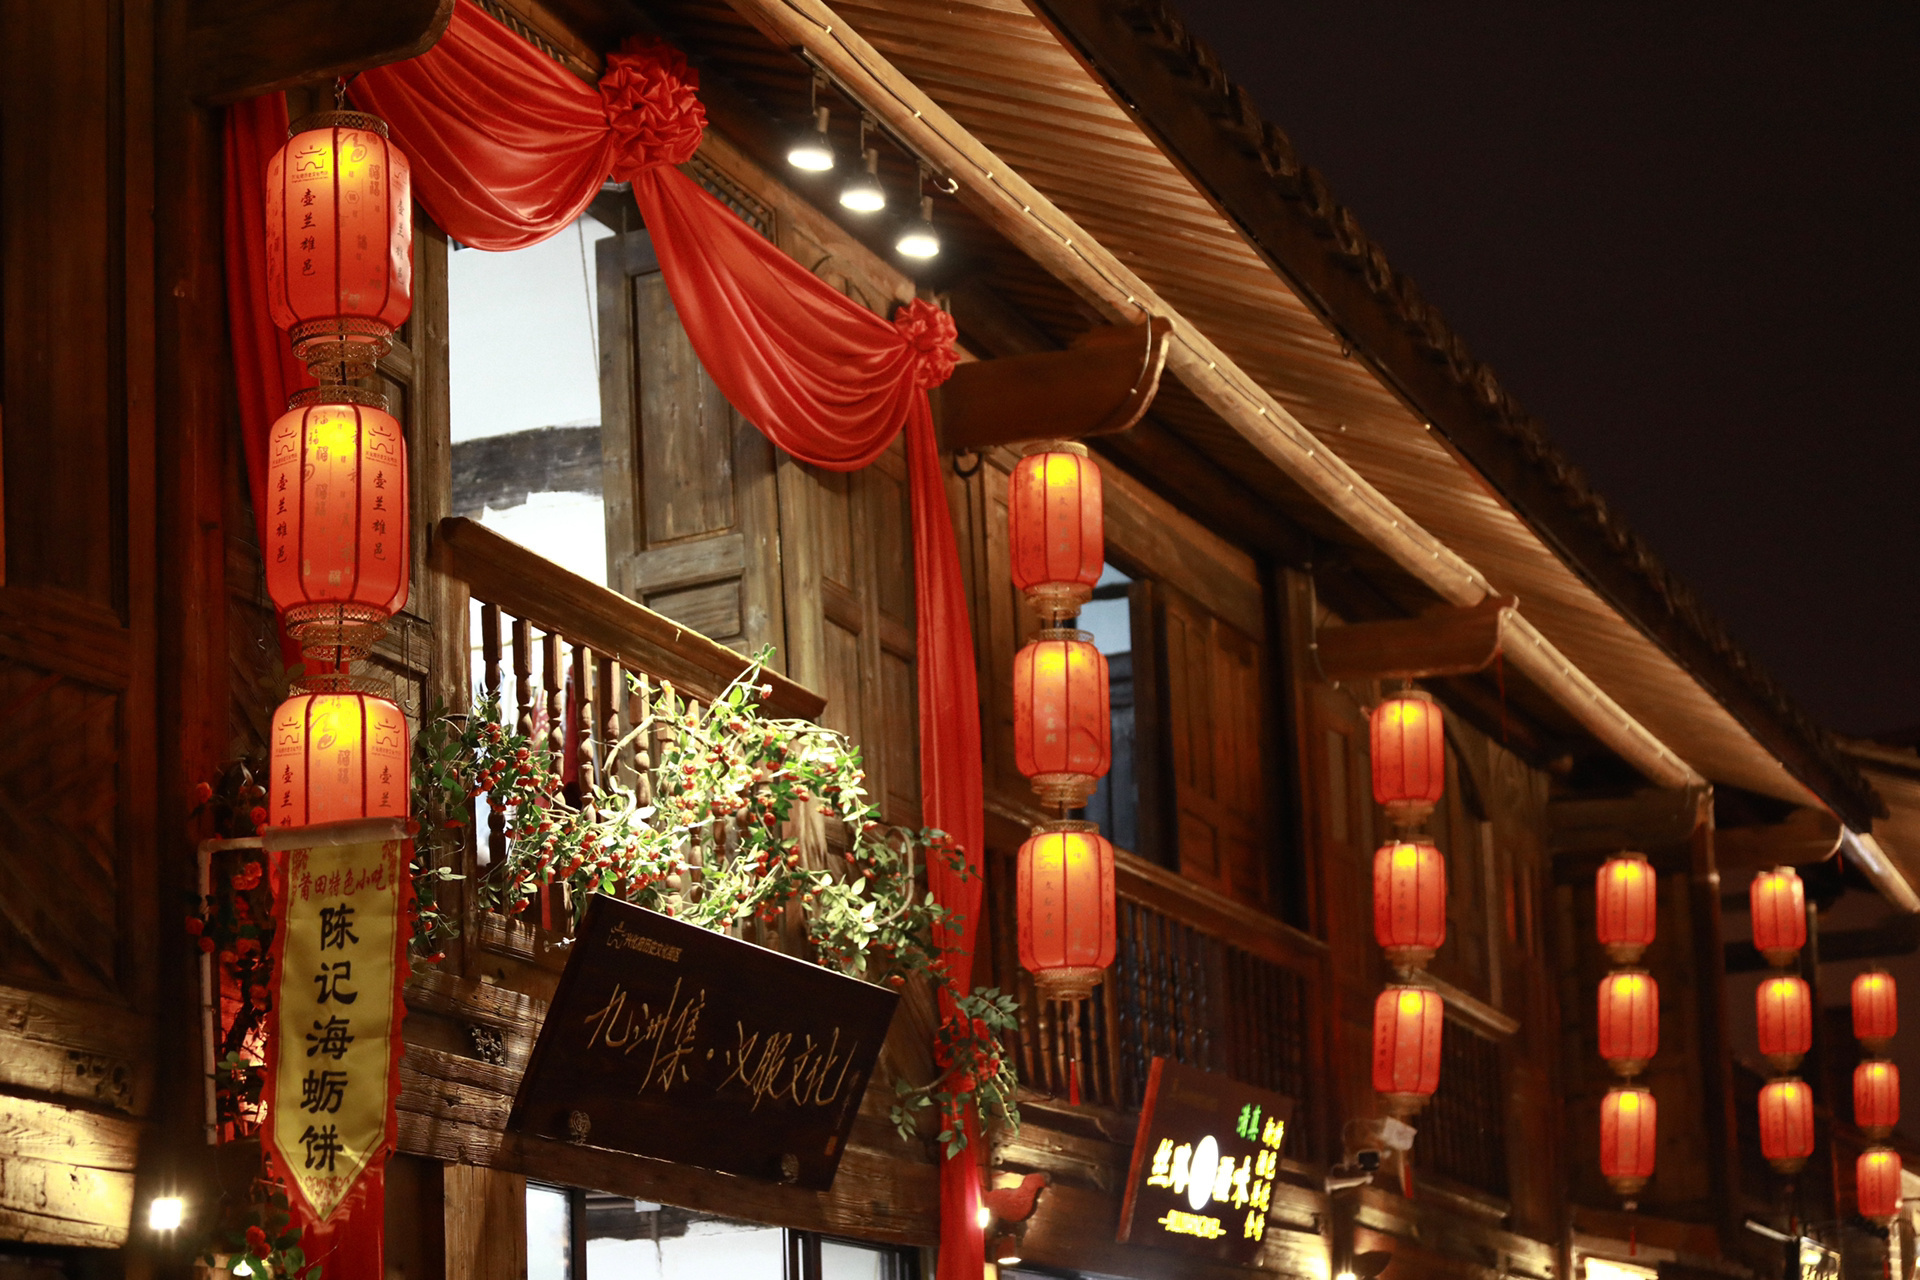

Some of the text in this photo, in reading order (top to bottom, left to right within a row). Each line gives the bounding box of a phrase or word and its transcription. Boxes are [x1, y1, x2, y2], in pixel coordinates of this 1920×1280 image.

[300, 188, 316, 277] 壶兰雄邑
[276, 472, 289, 564] 壶兰雄邑
[372, 470, 388, 561] 壶兰雄邑
[298, 863, 387, 901] 莆田特色小吃
[299, 904, 360, 1172] 陈记海蛎饼
